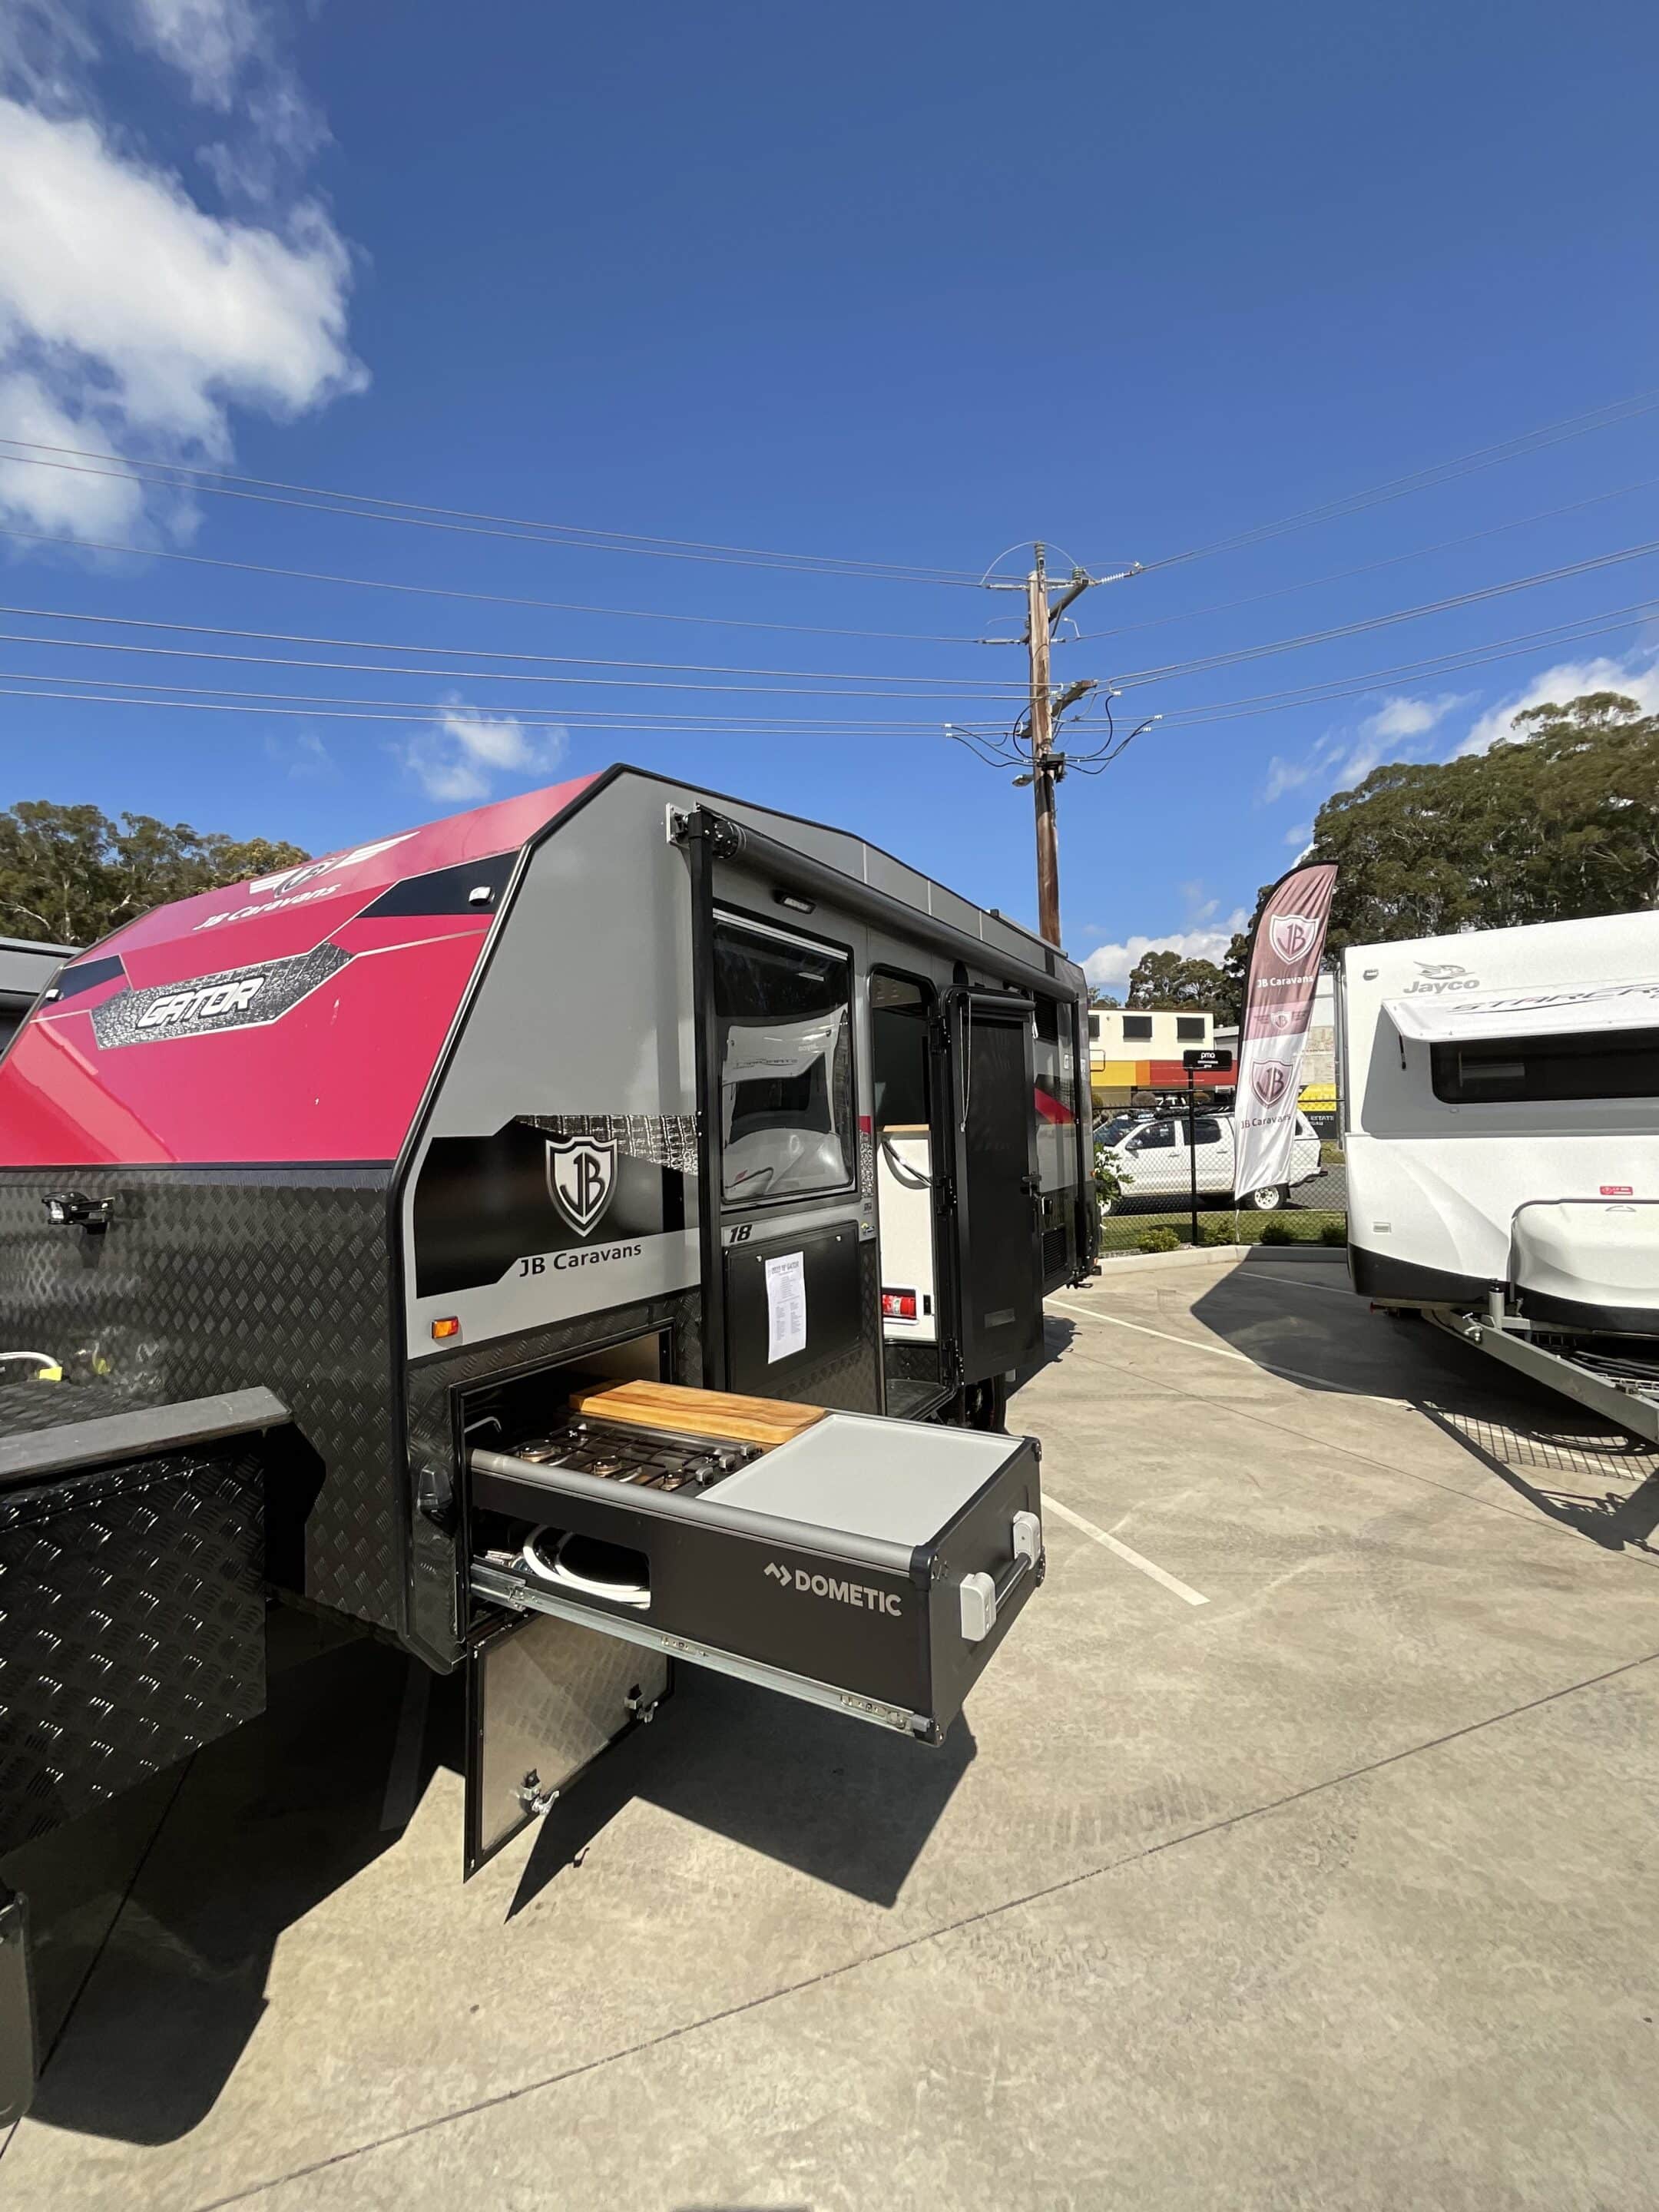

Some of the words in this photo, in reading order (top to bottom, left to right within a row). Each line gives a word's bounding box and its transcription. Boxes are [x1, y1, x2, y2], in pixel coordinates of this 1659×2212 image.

[193, 912, 230, 931] JB
[227, 883, 342, 922] Caravans
[1277, 922, 1306, 955] JB
[1257, 979, 1269, 988] JB
[1270, 975, 1314, 986] Caravans
[1402, 979, 1480, 995] Jayco
[136, 976, 266, 1028] GATOR
[1256, 1066, 1285, 1101] JB
[1241, 1119, 1251, 1129] JB
[559, 1151, 606, 1217] JB
[729, 1224, 753, 1243] 18
[519, 1257, 545, 1278] JB
[553, 1244, 642, 1270] Caravans
[795, 1569, 902, 1617] DOMETIC
